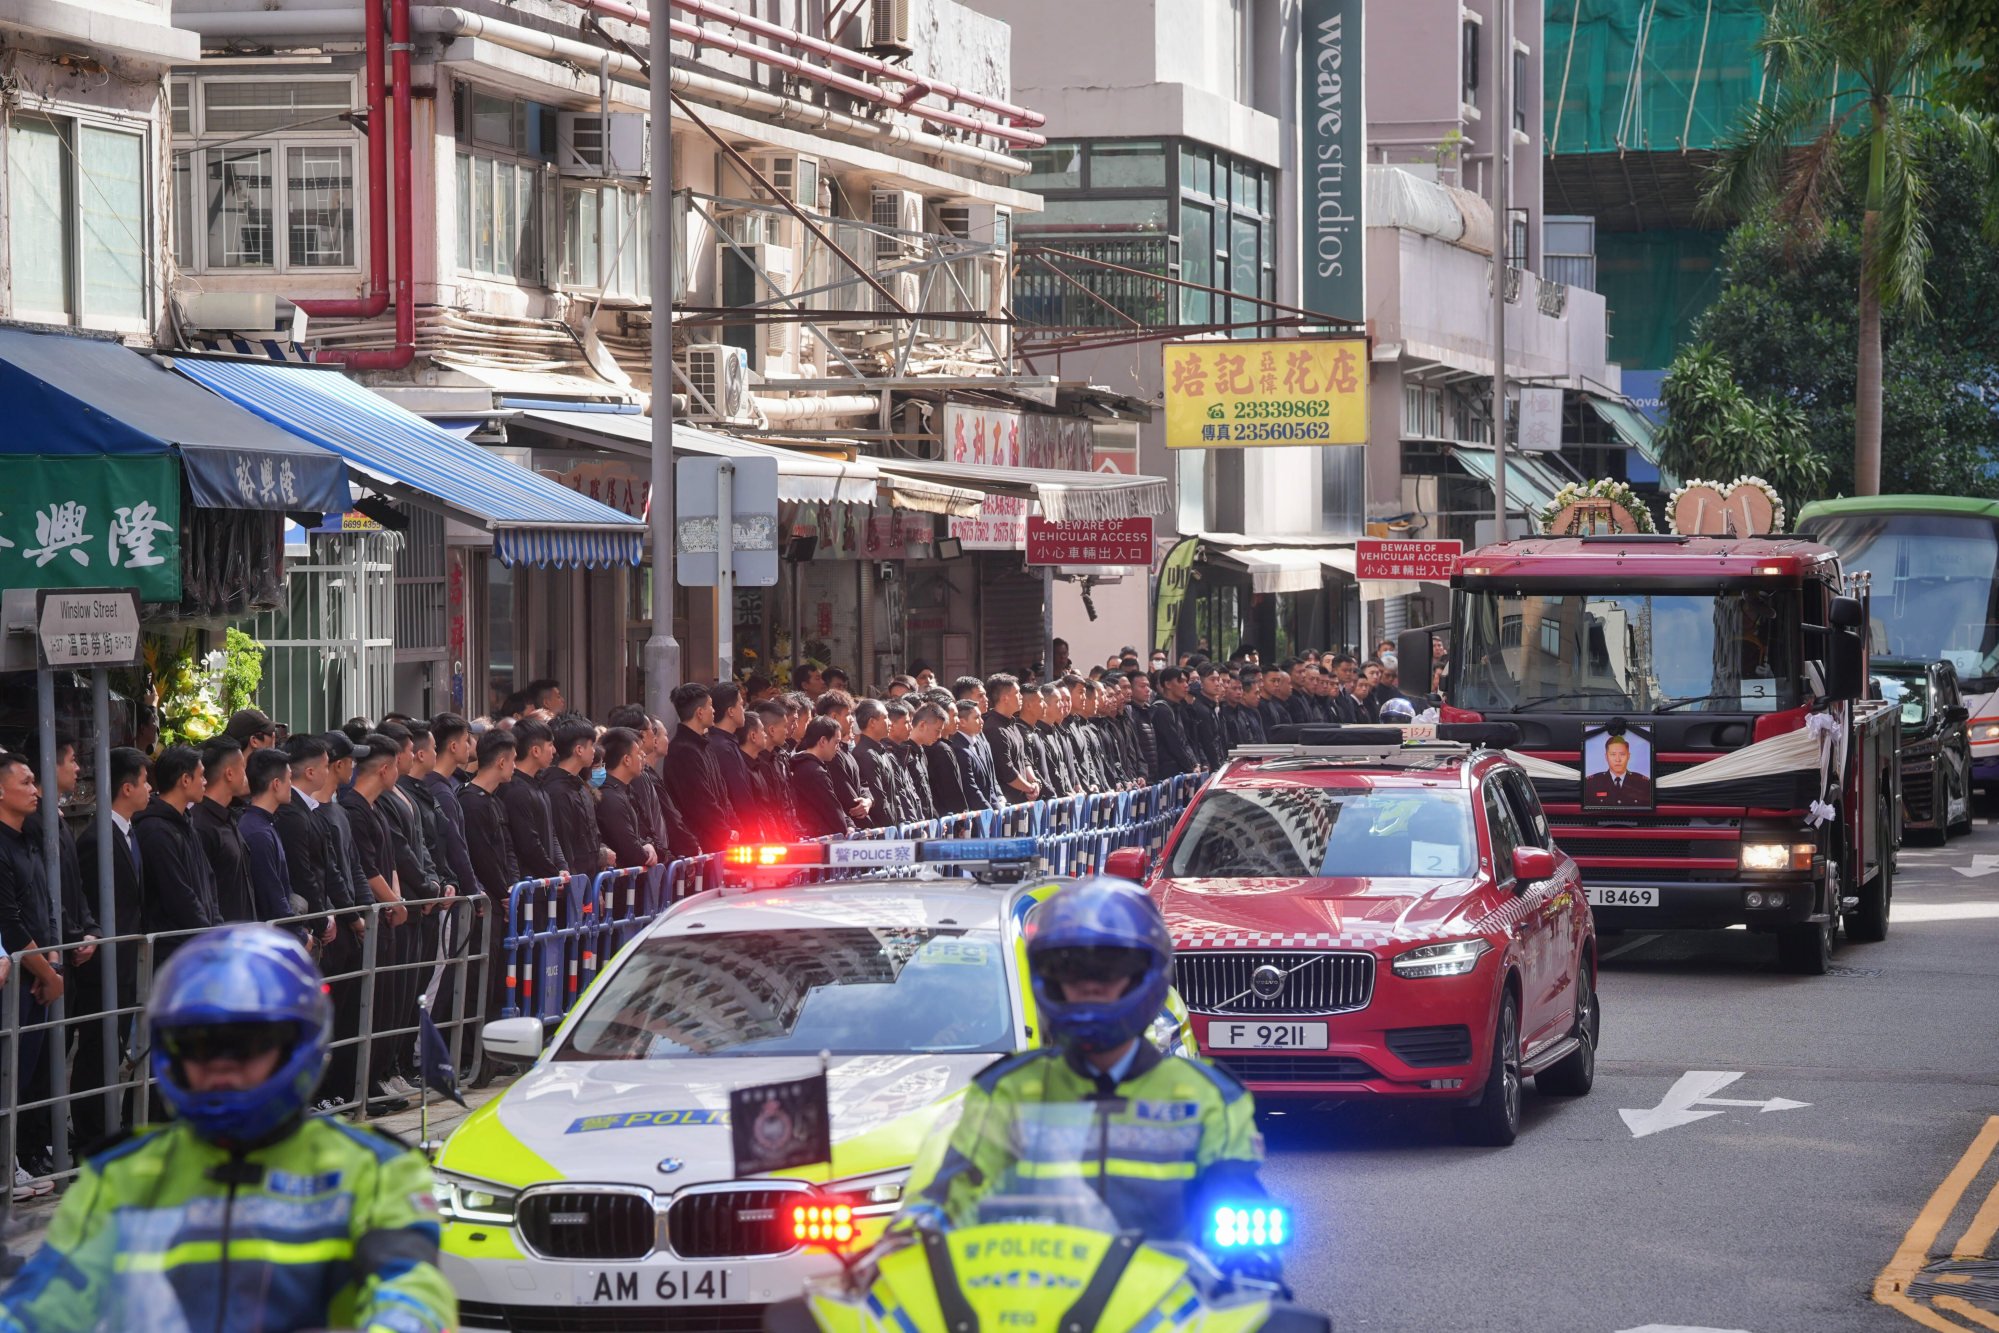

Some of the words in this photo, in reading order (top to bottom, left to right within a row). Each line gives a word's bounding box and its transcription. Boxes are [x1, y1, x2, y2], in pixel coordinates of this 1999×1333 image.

[1316, 13, 1343, 137] weave
[1316, 144, 1356, 278] studios
[1234, 400, 1330, 419] 23339862
[1202, 424, 1231, 441] 傳真
[1234, 422, 1330, 441] 23560562
[236, 456, 298, 504] 裕興隆
[343, 520, 361, 529] 6699
[1056, 520, 1105, 530] BEWARE
[1108, 521, 1123, 530] OF
[1032, 532, 1097, 541] VEHICULAR
[1101, 532, 1148, 542] ACCESS
[1037, 546, 1142, 560] 小心車輛出入口
[1381, 544, 1421, 552] BEWARE
[1424, 544, 1436, 552] OF
[1360, 552, 1414, 561] VEHICULAR
[1418, 553, 1457, 562] ACCESS
[1364, 564, 1453, 576] 小心車輛出入口
[60, 601, 91, 619] Winslow
[93, 601, 118, 618] Street
[1753, 685, 1765, 698] 3
[852, 848, 893, 860] POLICE
[1427, 856, 1442, 871] 2
[1599, 889, 1652, 905] 18469
[1230, 1025, 1245, 1045] F
[1257, 1025, 1304, 1045] 9211
[985, 1238, 1064, 1259] POLICE
[593, 1271, 638, 1301] AM
[656, 1270, 727, 1300] 6141
